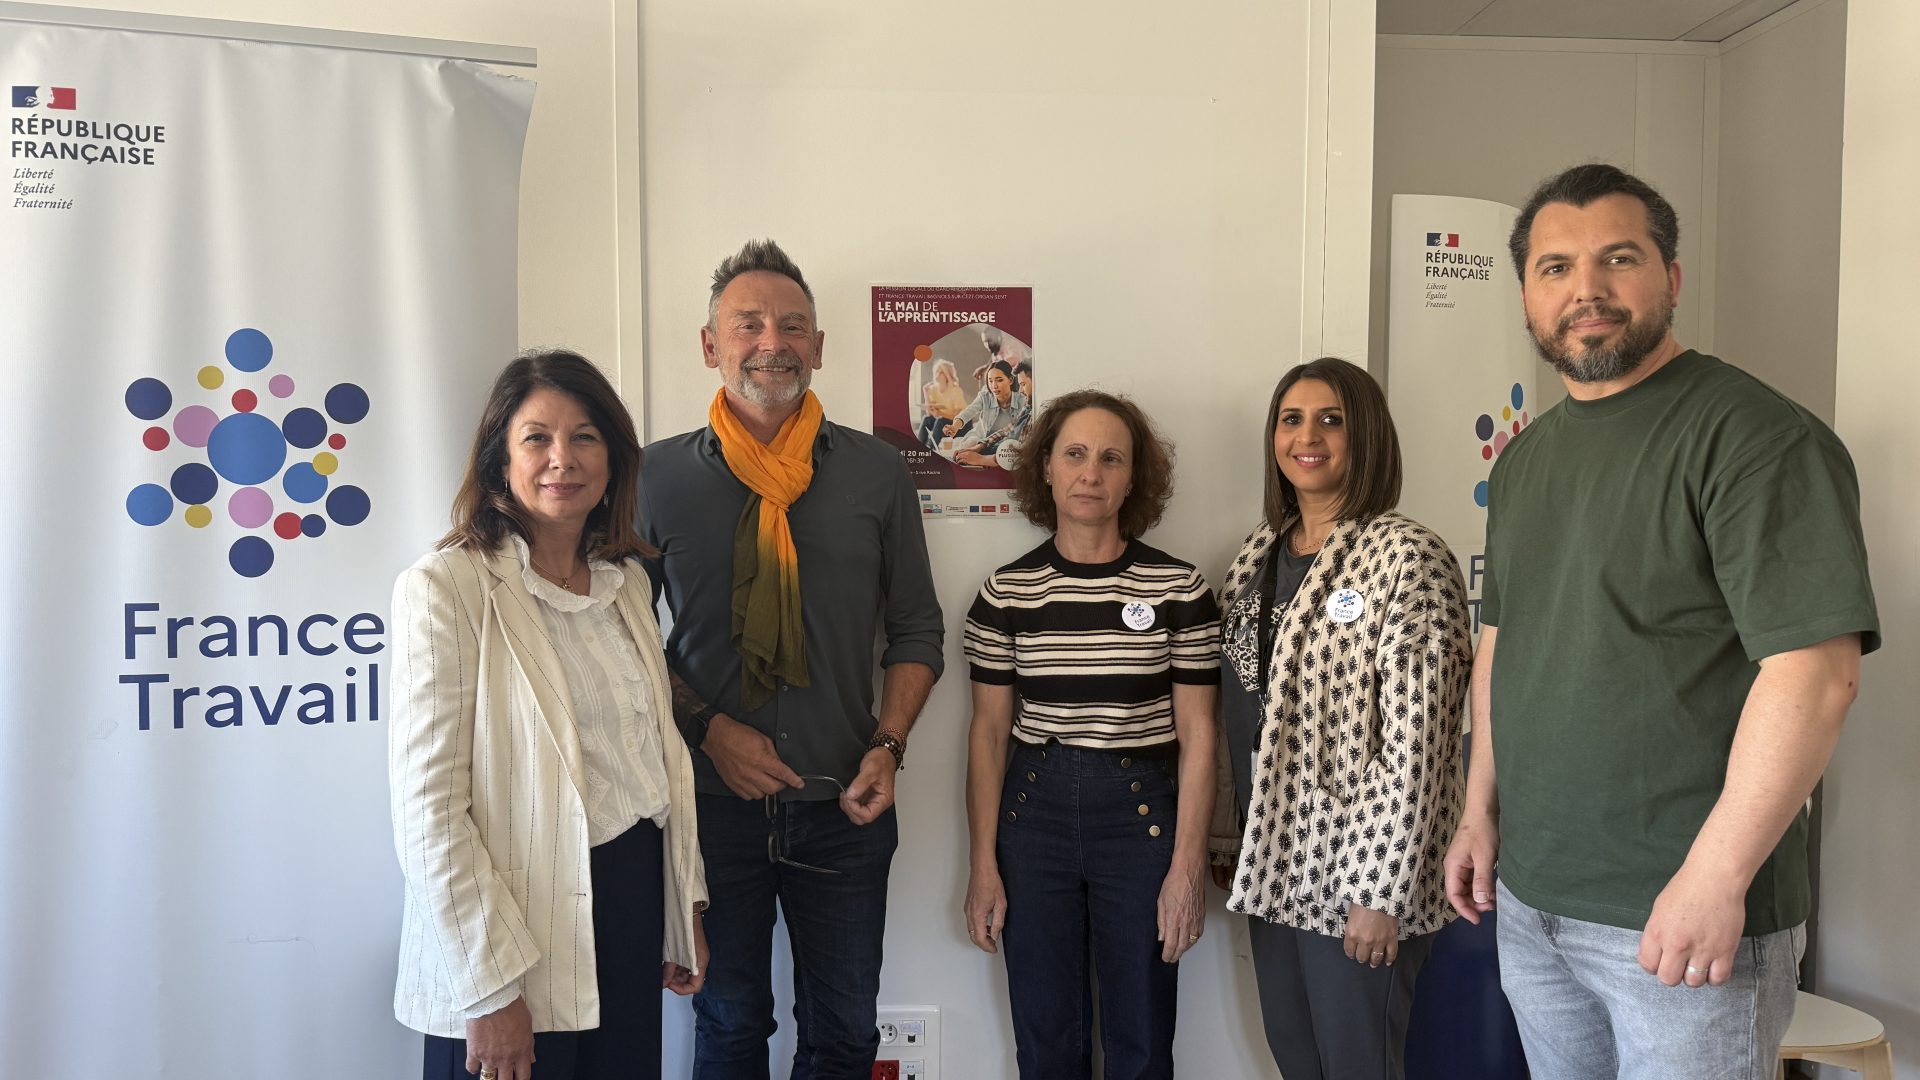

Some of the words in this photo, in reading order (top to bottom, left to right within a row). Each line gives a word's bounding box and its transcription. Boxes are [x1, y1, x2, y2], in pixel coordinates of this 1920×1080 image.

[11, 114, 166, 145] RÉPUBLIQUE
[11, 140, 155, 165] FRANÇAISE
[13, 168, 54, 179] Liberté
[13, 181, 55, 196] Égalité
[13, 198, 73, 210] Fraternité
[1425, 250, 1493, 268] RÉPUBLIQUE
[1425, 266, 1490, 280] FRANÇAISE
[1425, 291, 1448, 300] Égalité
[878, 301, 892, 311] LE
[895, 301, 919, 311] MAI
[923, 301, 939, 311] DE
[1425, 301, 1456, 309] Fraternité
[124, 602, 386, 660] France
[118, 663, 379, 731] Travail
